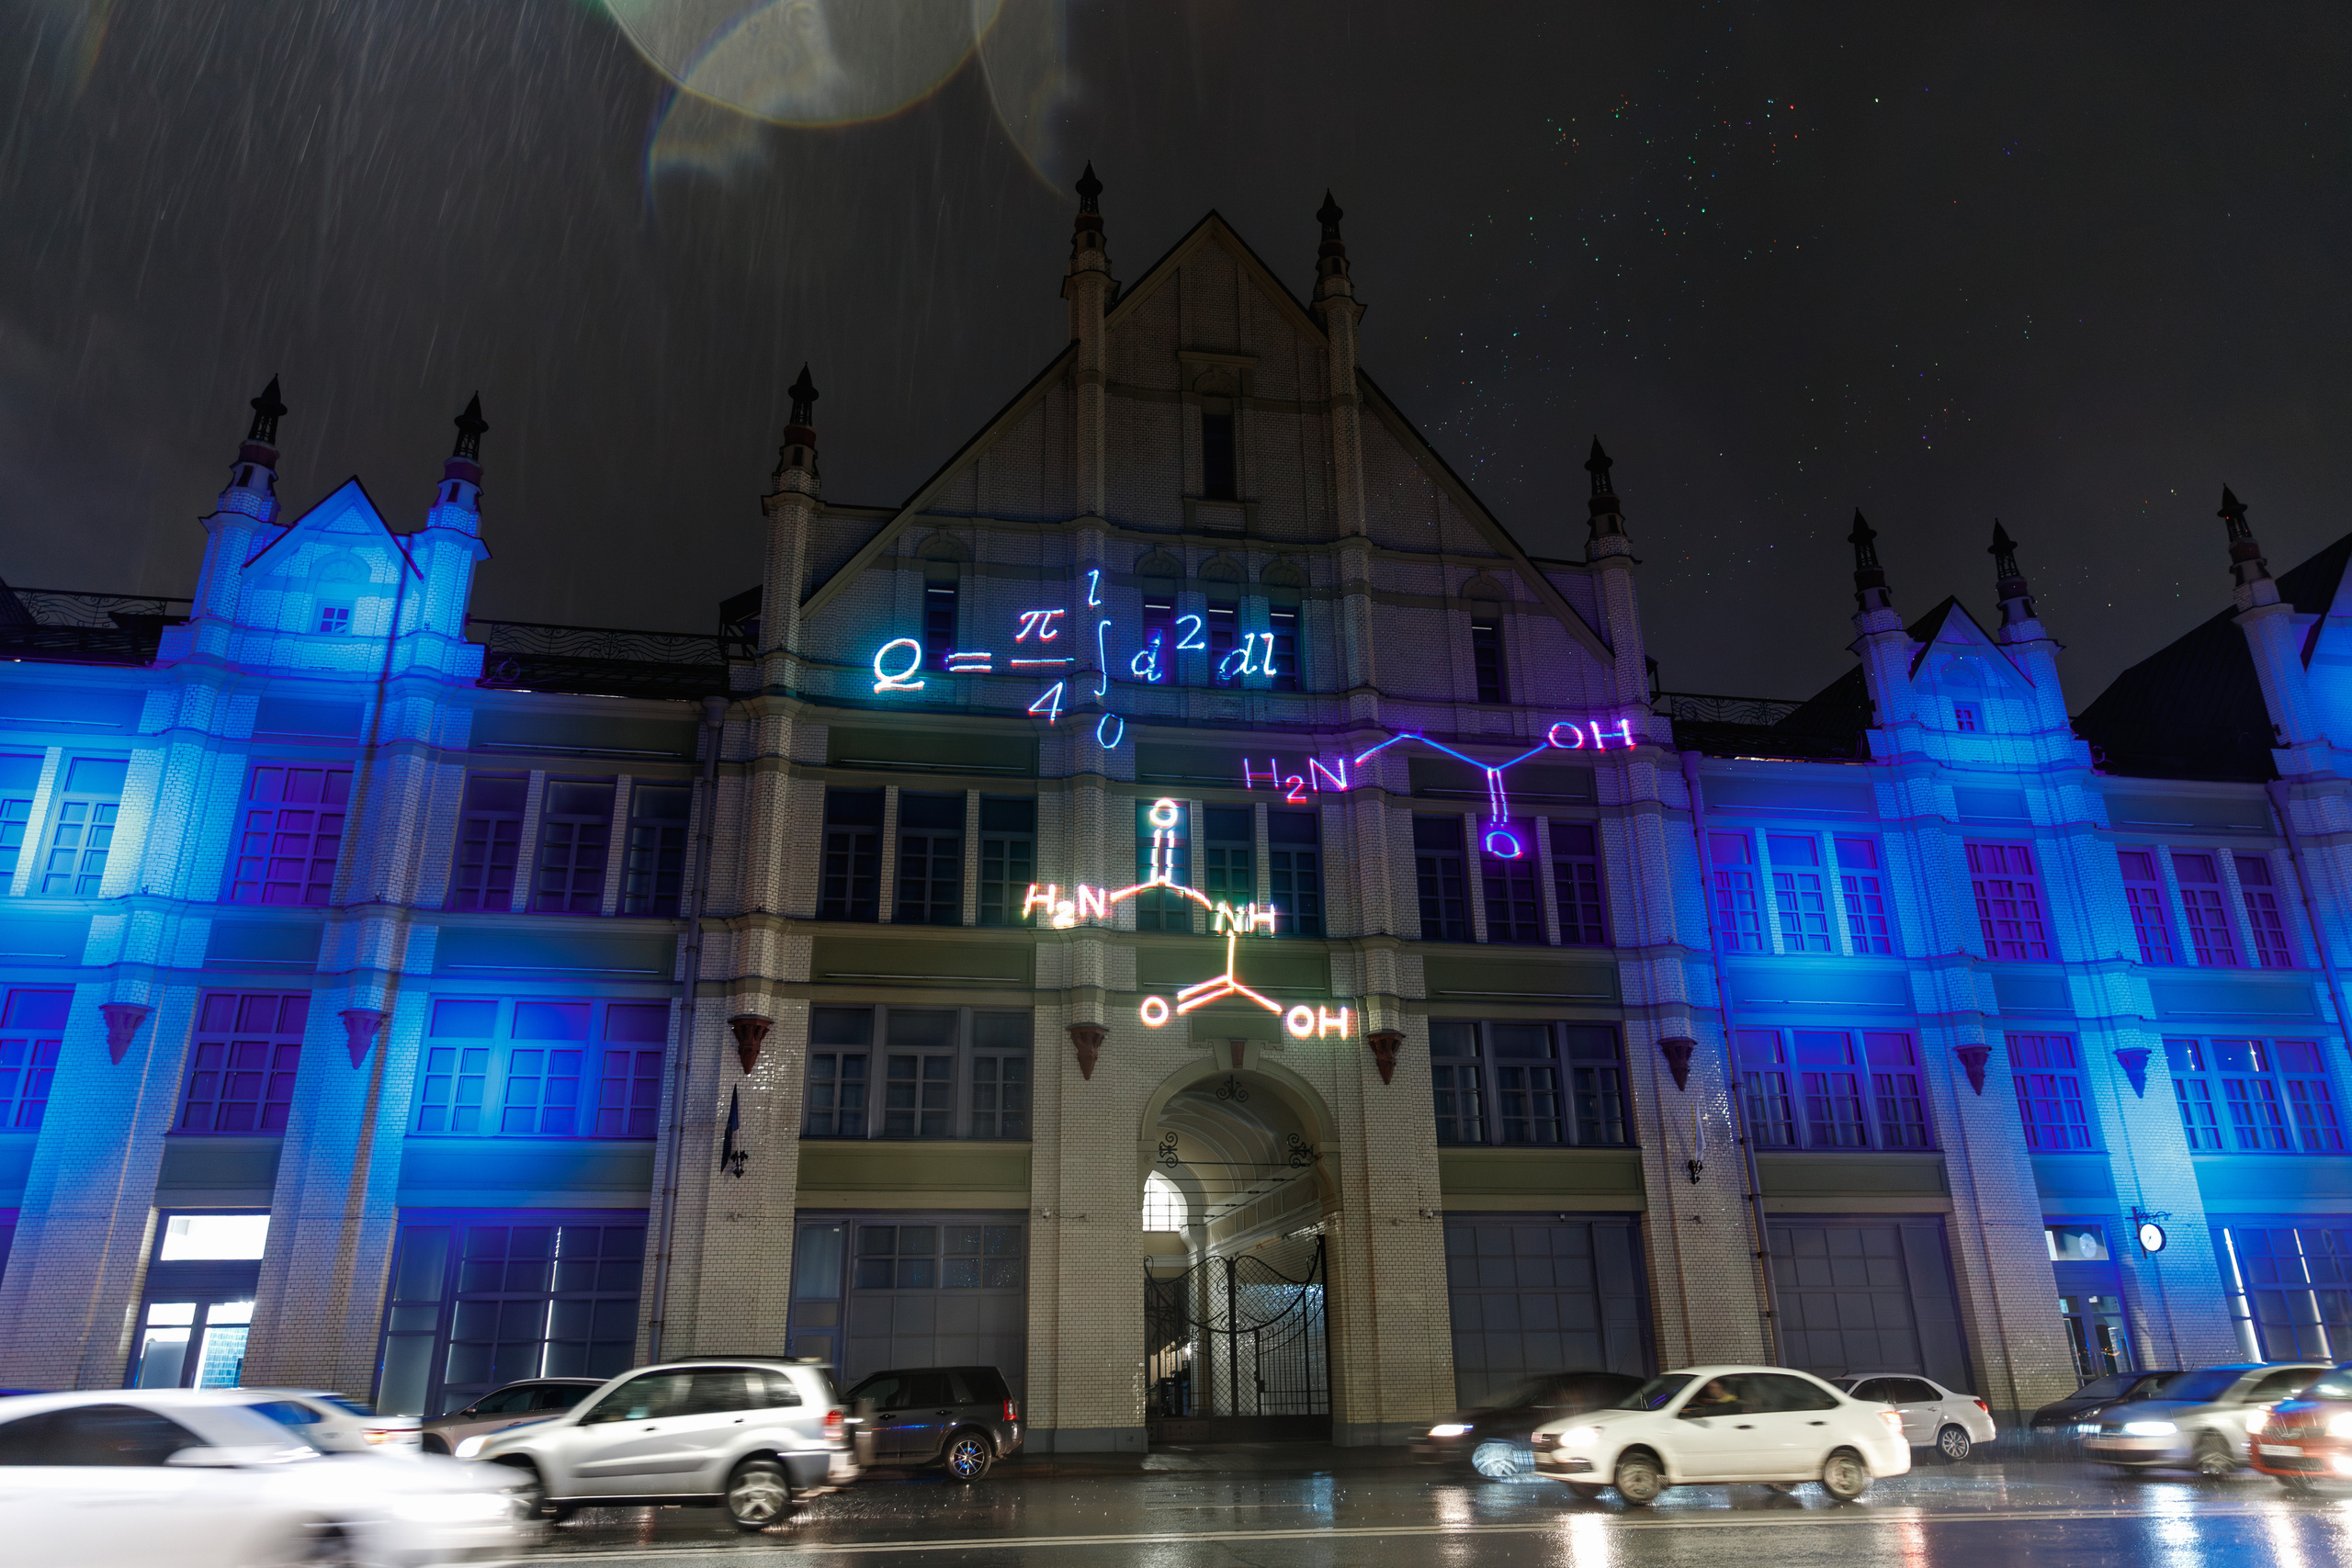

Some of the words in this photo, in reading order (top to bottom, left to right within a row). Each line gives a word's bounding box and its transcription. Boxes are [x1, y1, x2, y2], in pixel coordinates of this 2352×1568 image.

[872, 637, 925, 694] Q
[1028, 681, 1065, 723] 4
[1547, 718, 1635, 751] OH
[1215, 901, 1277, 935] NH
[1286, 1004, 1350, 1040] OH
